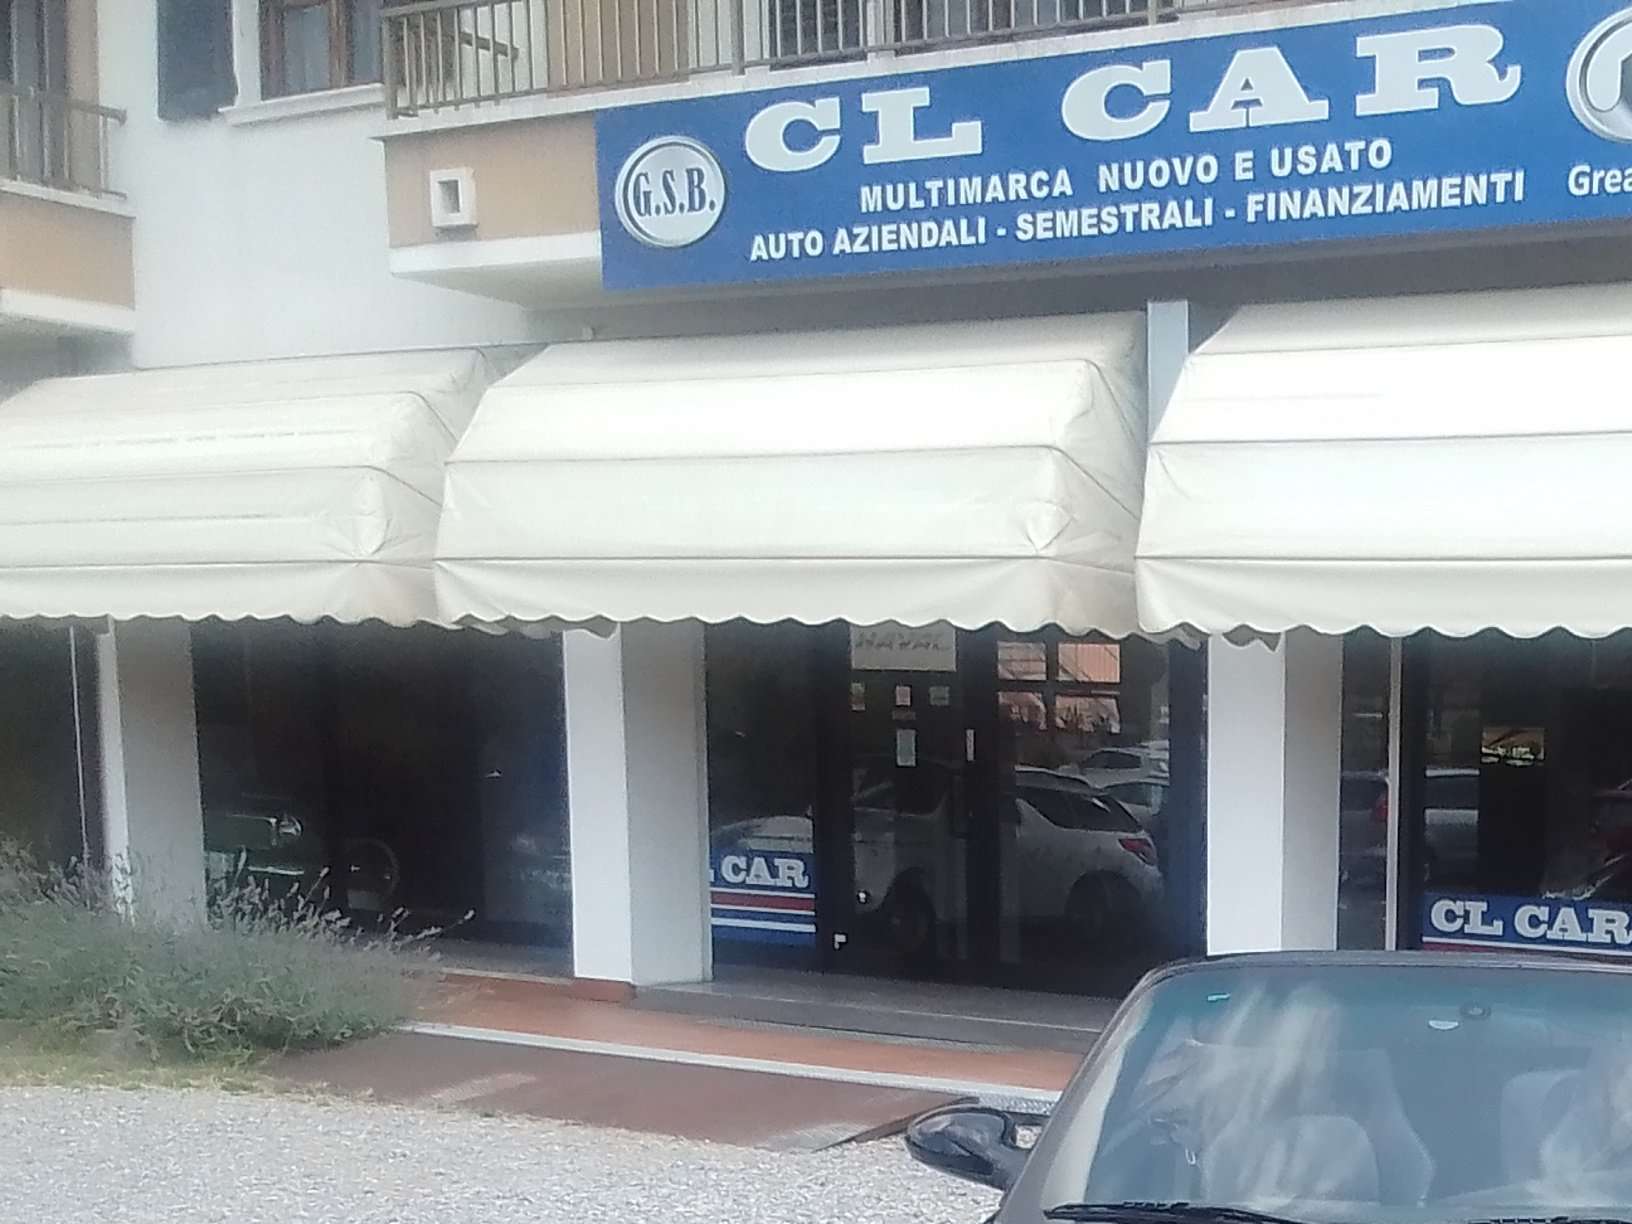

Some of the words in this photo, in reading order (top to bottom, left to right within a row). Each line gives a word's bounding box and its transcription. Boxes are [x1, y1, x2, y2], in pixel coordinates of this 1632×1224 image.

[744, 86, 984, 173] CL
[1060, 22, 1522, 142] CAR
[632, 167, 716, 217] G.S.B.
[860, 167, 1075, 214] MULTIMARCA
[1098, 153, 1219, 194] NUOVO
[1234, 150, 1255, 182] E
[1269, 138, 1393, 178] USATO
[749, 229, 823, 263] AUTO
[832, 216, 987, 256] AZIENDALI
[1016, 206, 1214, 242] SEMESTRALI
[1246, 170, 1525, 223] FINANZIAMENTI
[721, 855, 809, 888] CAR
[1431, 899, 1504, 936] CL
